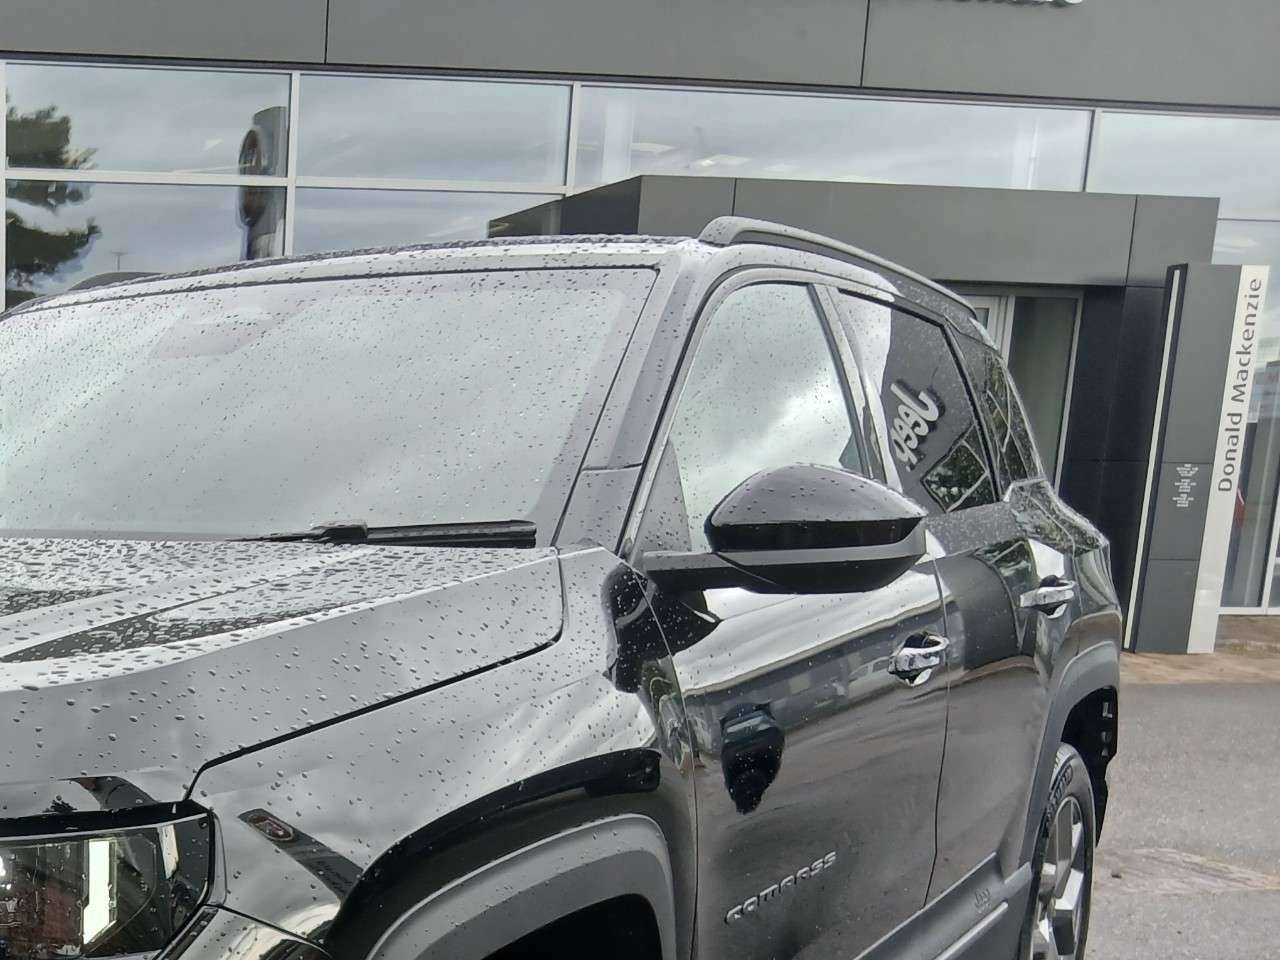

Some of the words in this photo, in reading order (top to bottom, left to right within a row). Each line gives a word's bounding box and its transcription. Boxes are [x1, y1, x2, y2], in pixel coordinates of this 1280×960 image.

[1218, 412, 1243, 492] Donald
[1231, 278, 1262, 403] Mackenzie
[724, 851, 837, 924] COMPASS
